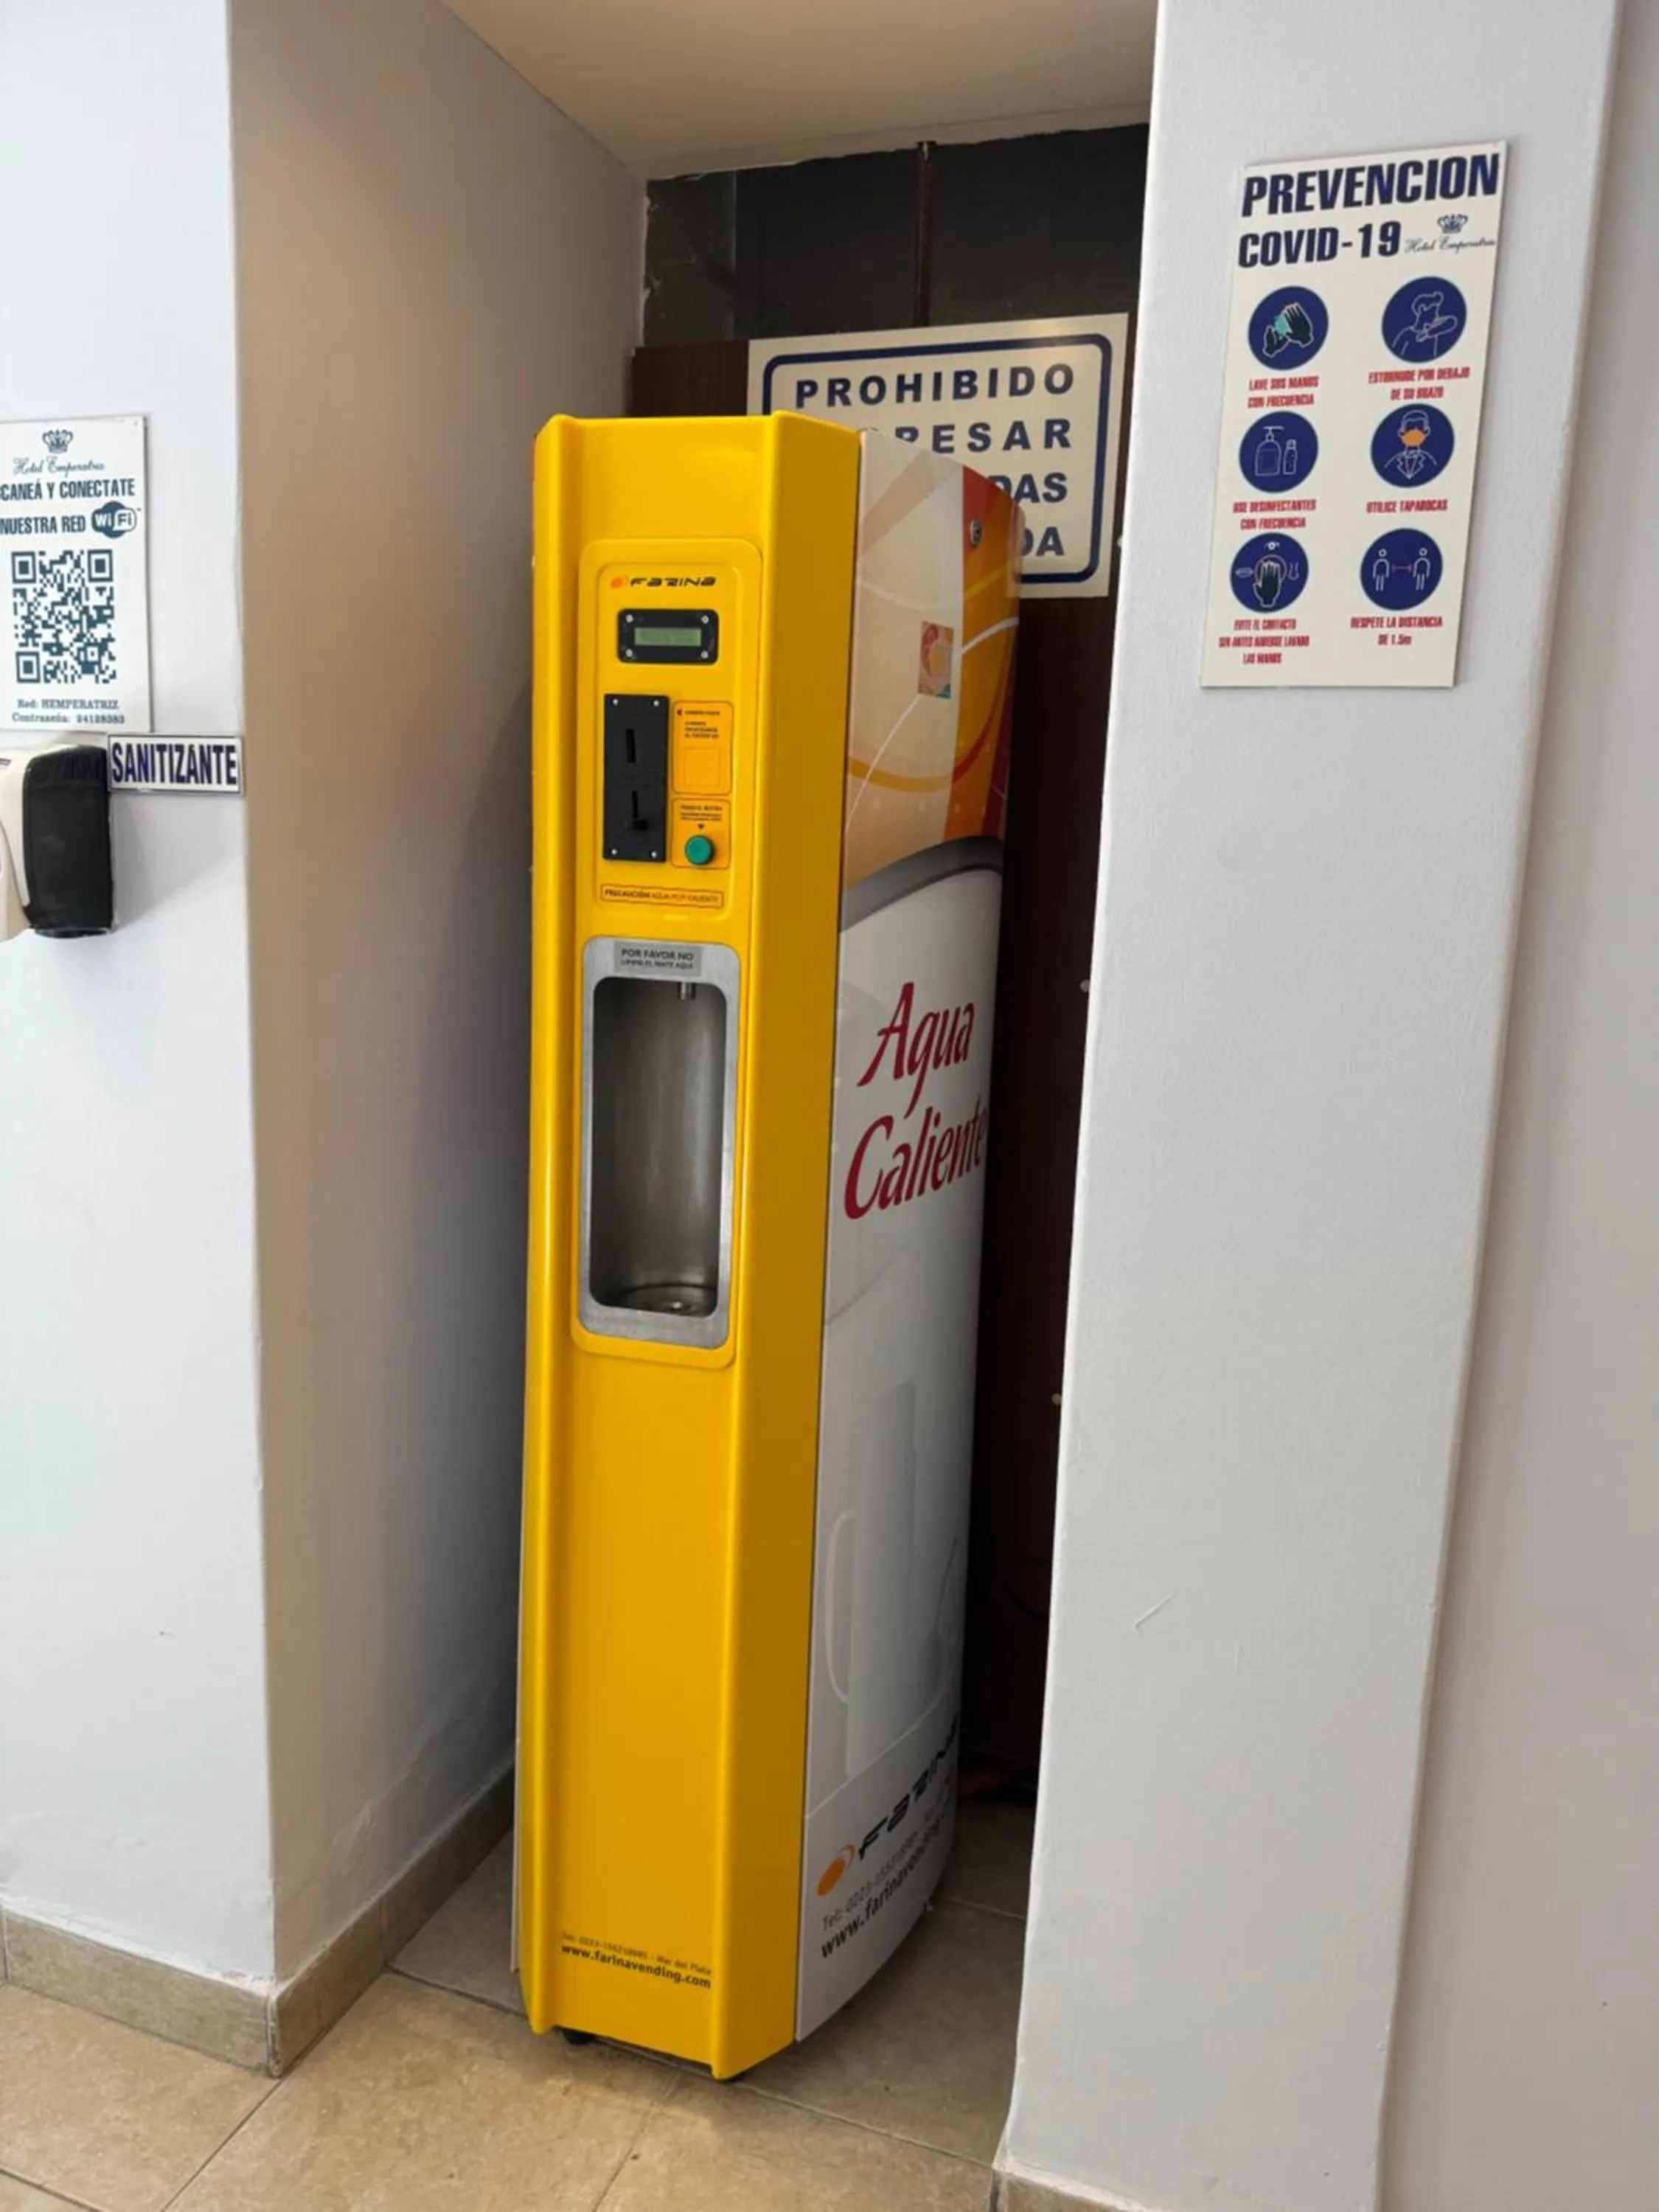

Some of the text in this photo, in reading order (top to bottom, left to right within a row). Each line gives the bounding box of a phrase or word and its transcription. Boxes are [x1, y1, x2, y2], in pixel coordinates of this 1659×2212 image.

[1241, 153, 1500, 218] PREVENCION
[1238, 220, 1402, 268] COVID-19
[1404, 237, 1436, 254] Hotel
[1418, 369, 1435, 382] POR
[1437, 366, 1470, 380] DEBAJO
[796, 364, 1074, 408] PROHIBIDO
[1270, 378, 1286, 389] SUS
[1288, 376, 1319, 389] MANOS
[1266, 393, 1314, 408] FRECUENCIA
[1391, 386, 1444, 400] DE SU BRAZO
[13, 457, 44, 476] Hotel
[46, 482, 55, 499] Y
[59, 478, 136, 498] CONECTATE
[1233, 502, 1247, 513] USE
[1366, 498, 1448, 514] UTILICE TAPABOCAS
[0, 515, 58, 535] NUESTRA
[61, 515, 86, 533] RED
[1240, 517, 1306, 529] CON FRECUENCIA
[1350, 616, 1443, 629] RESPETE LA DISTANCIA
[1378, 634, 1388, 645] DE
[1242, 653, 1256, 665] LAS
[17, 698, 119, 710] Red: HEMPERATRIZ
[111, 742, 238, 785] SANITIZANTE
[622, 947, 694, 961] POR FAVOR NO
[857, 981, 975, 1120] Agua
[561, 1944, 712, 1989] www.farinavending.com
